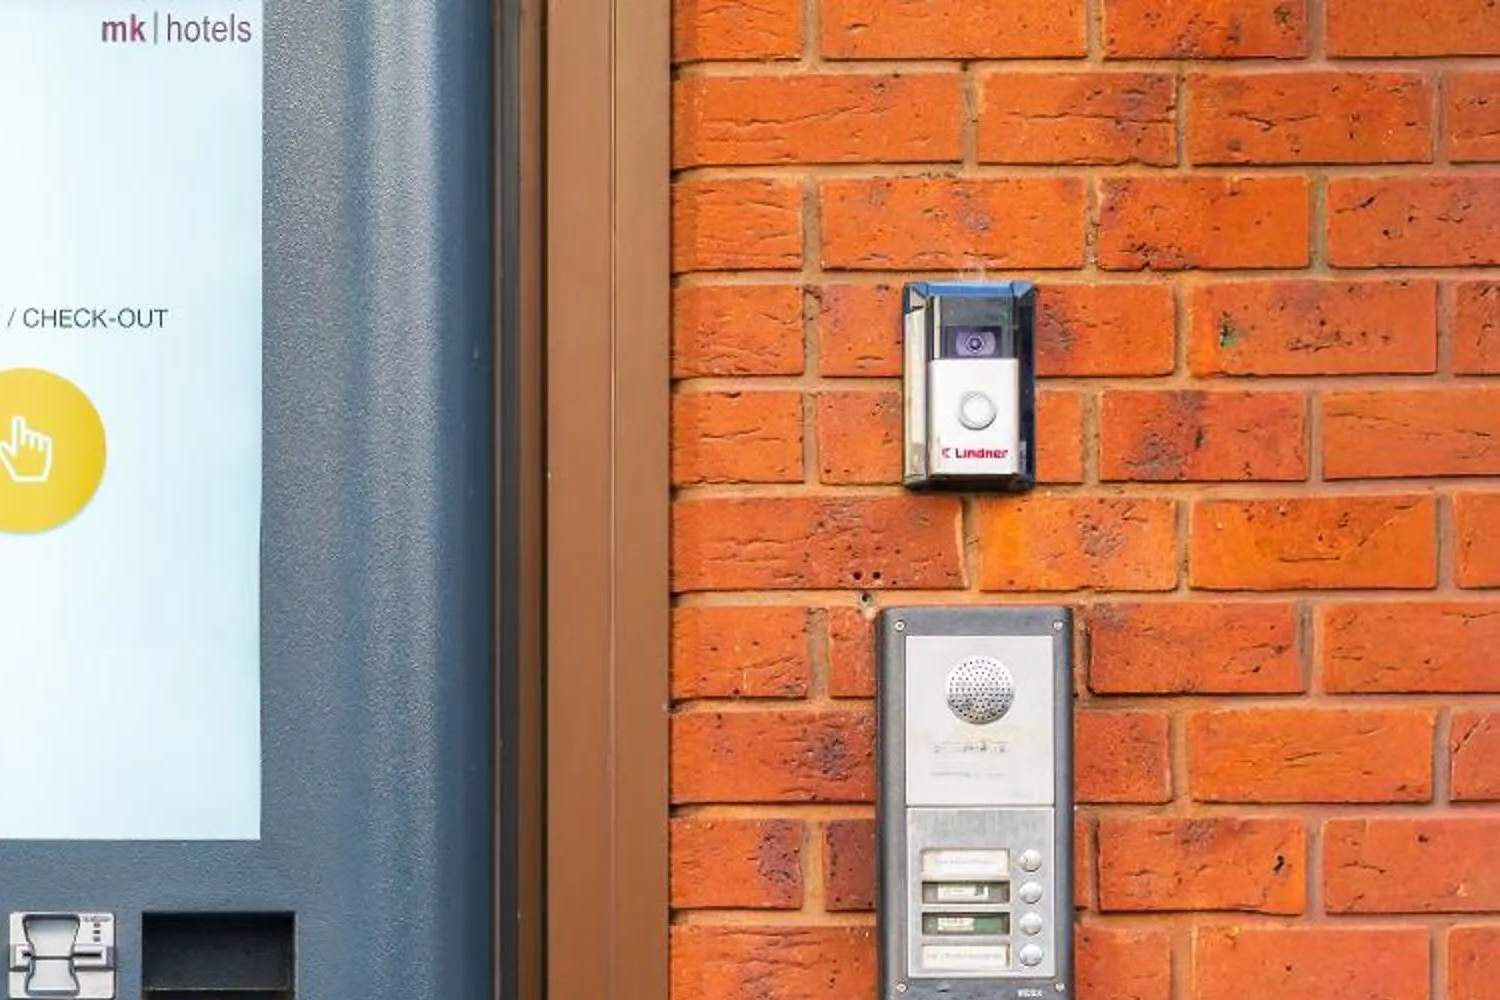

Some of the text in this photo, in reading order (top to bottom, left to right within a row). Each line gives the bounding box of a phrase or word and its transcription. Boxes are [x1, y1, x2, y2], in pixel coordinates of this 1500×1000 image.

[101, 13, 147, 42] mk
[167, 13, 252, 42] hotels
[23, 307, 169, 329] CHECK-OUT
[955, 447, 1009, 459] Lindner
